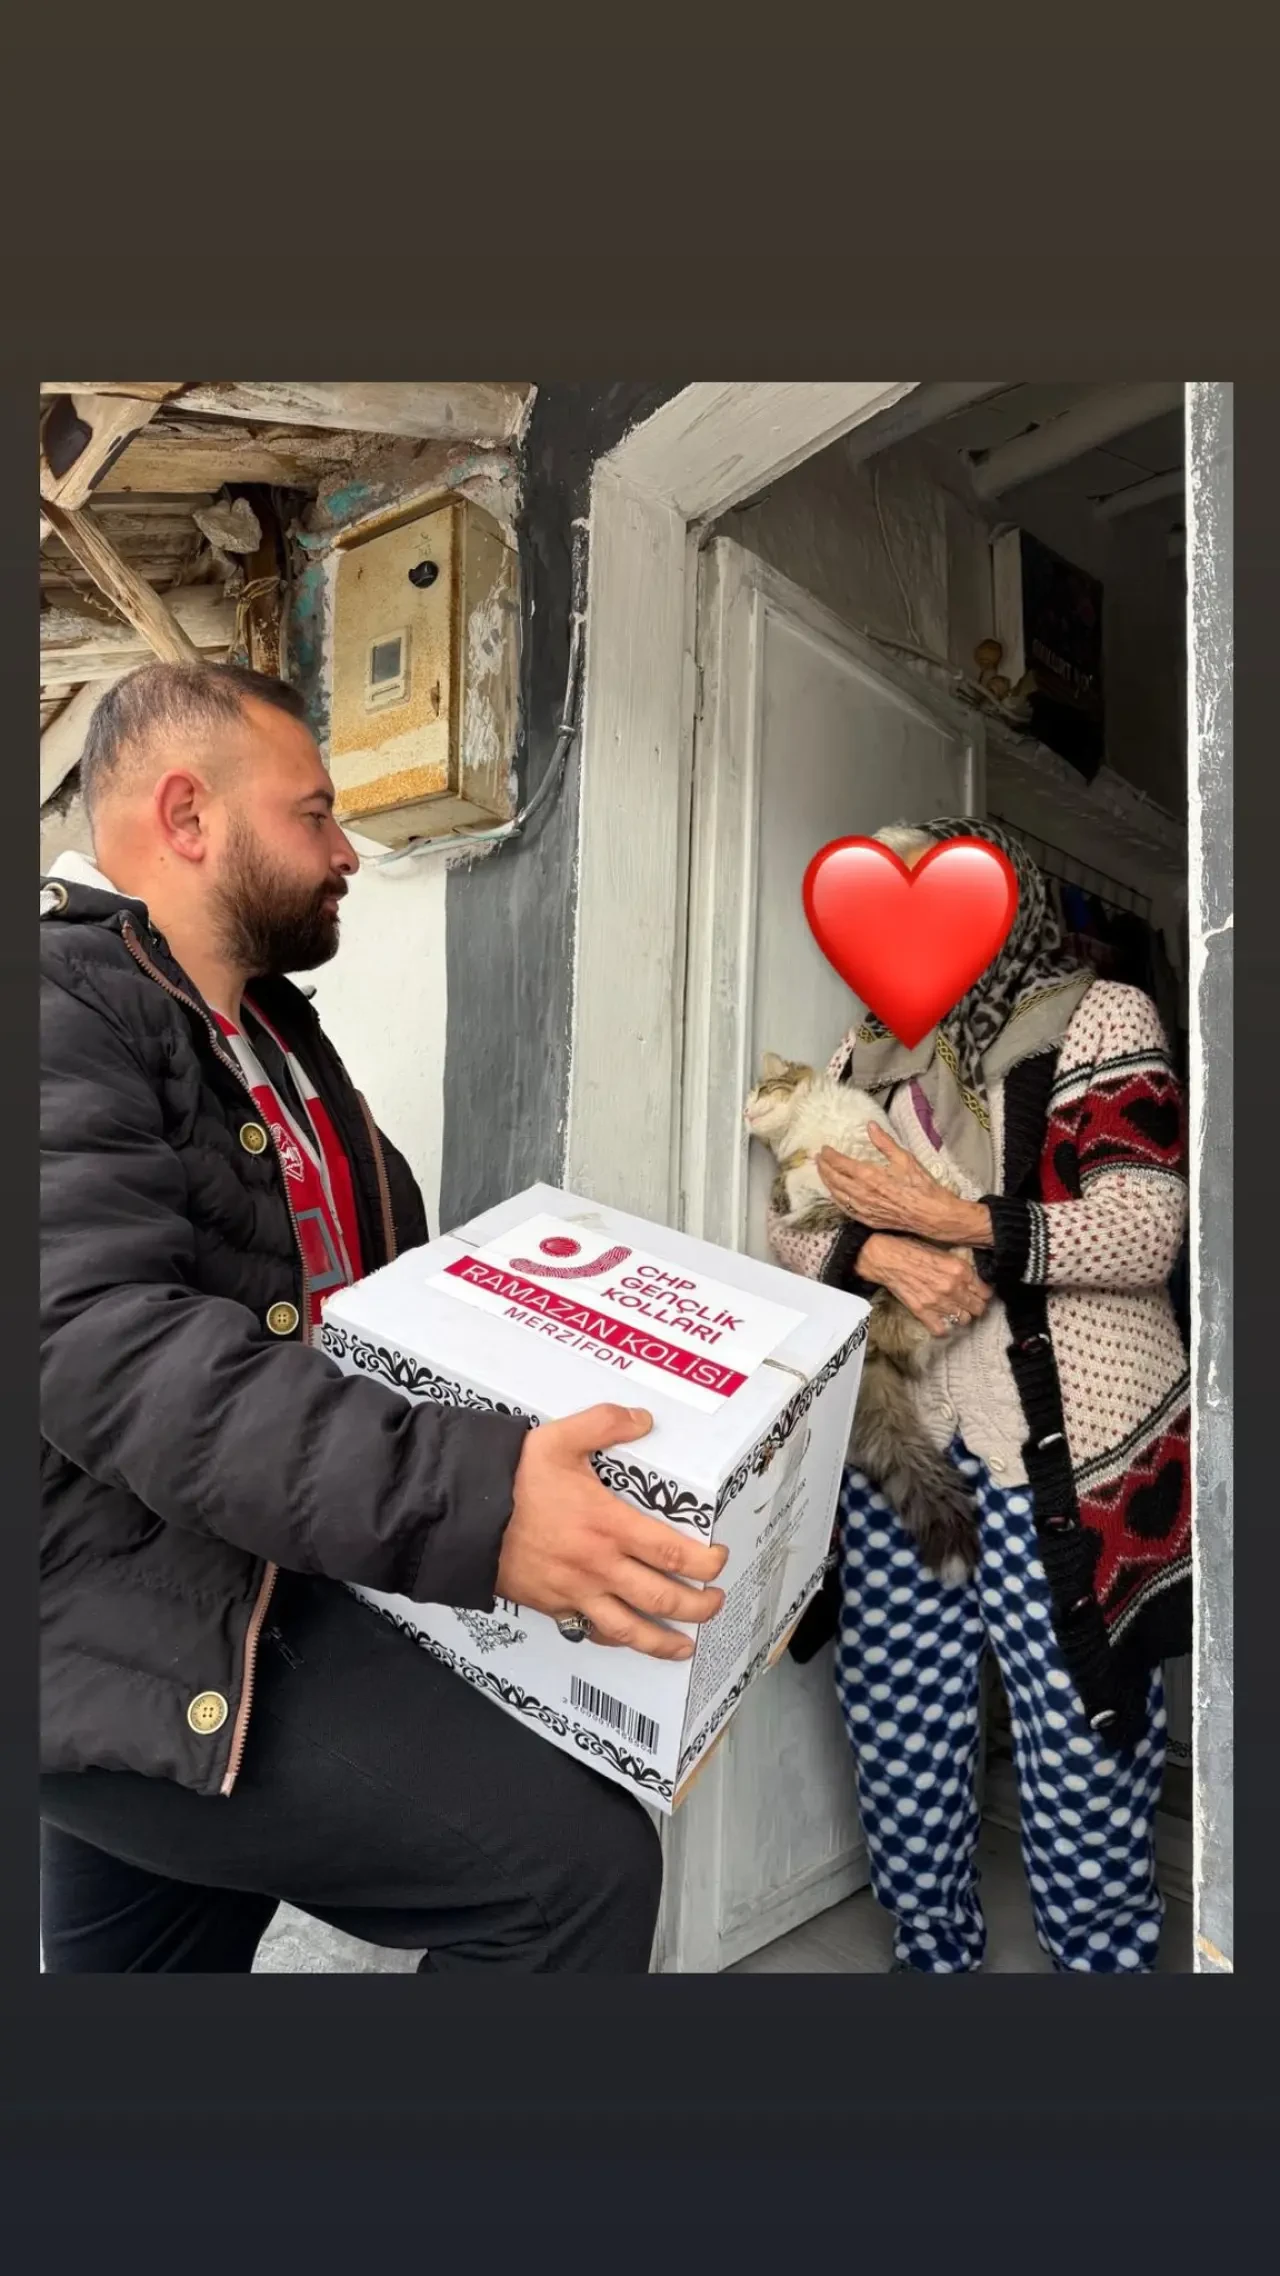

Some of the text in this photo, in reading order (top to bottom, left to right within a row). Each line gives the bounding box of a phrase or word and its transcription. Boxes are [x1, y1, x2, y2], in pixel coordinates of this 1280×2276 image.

[620, 1277, 745, 1331] GENÇLİK
[636, 1265, 697, 1291] CHP
[461, 1263, 734, 1390] RAMAZAN KOLİSİ
[503, 1307, 634, 1371] MERZİFON
[600, 1287, 723, 1345] KOLLARI
